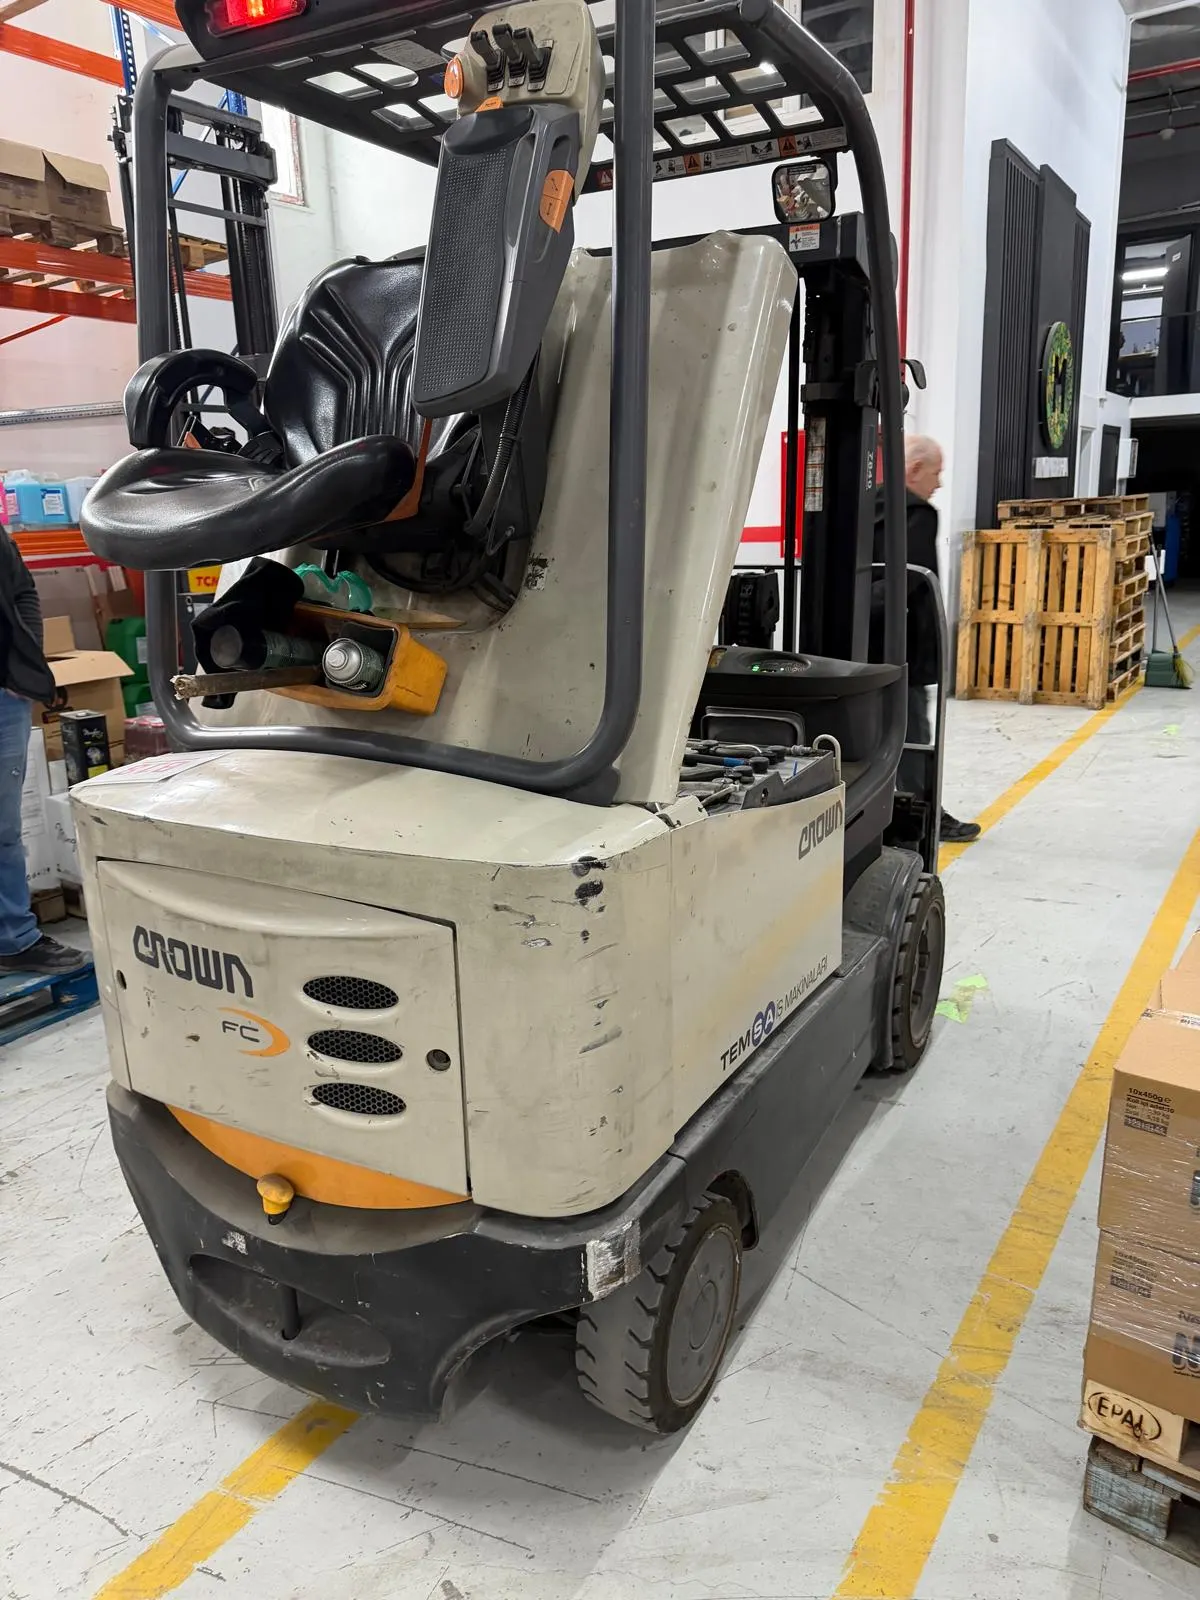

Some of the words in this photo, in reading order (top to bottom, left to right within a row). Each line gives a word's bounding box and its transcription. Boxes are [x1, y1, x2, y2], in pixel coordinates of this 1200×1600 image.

[798, 799, 843, 861] CROWN
[133, 925, 254, 998] CROWN
[222, 1020, 260, 1043] FC
[720, 1002, 775, 1071] TEMSA
